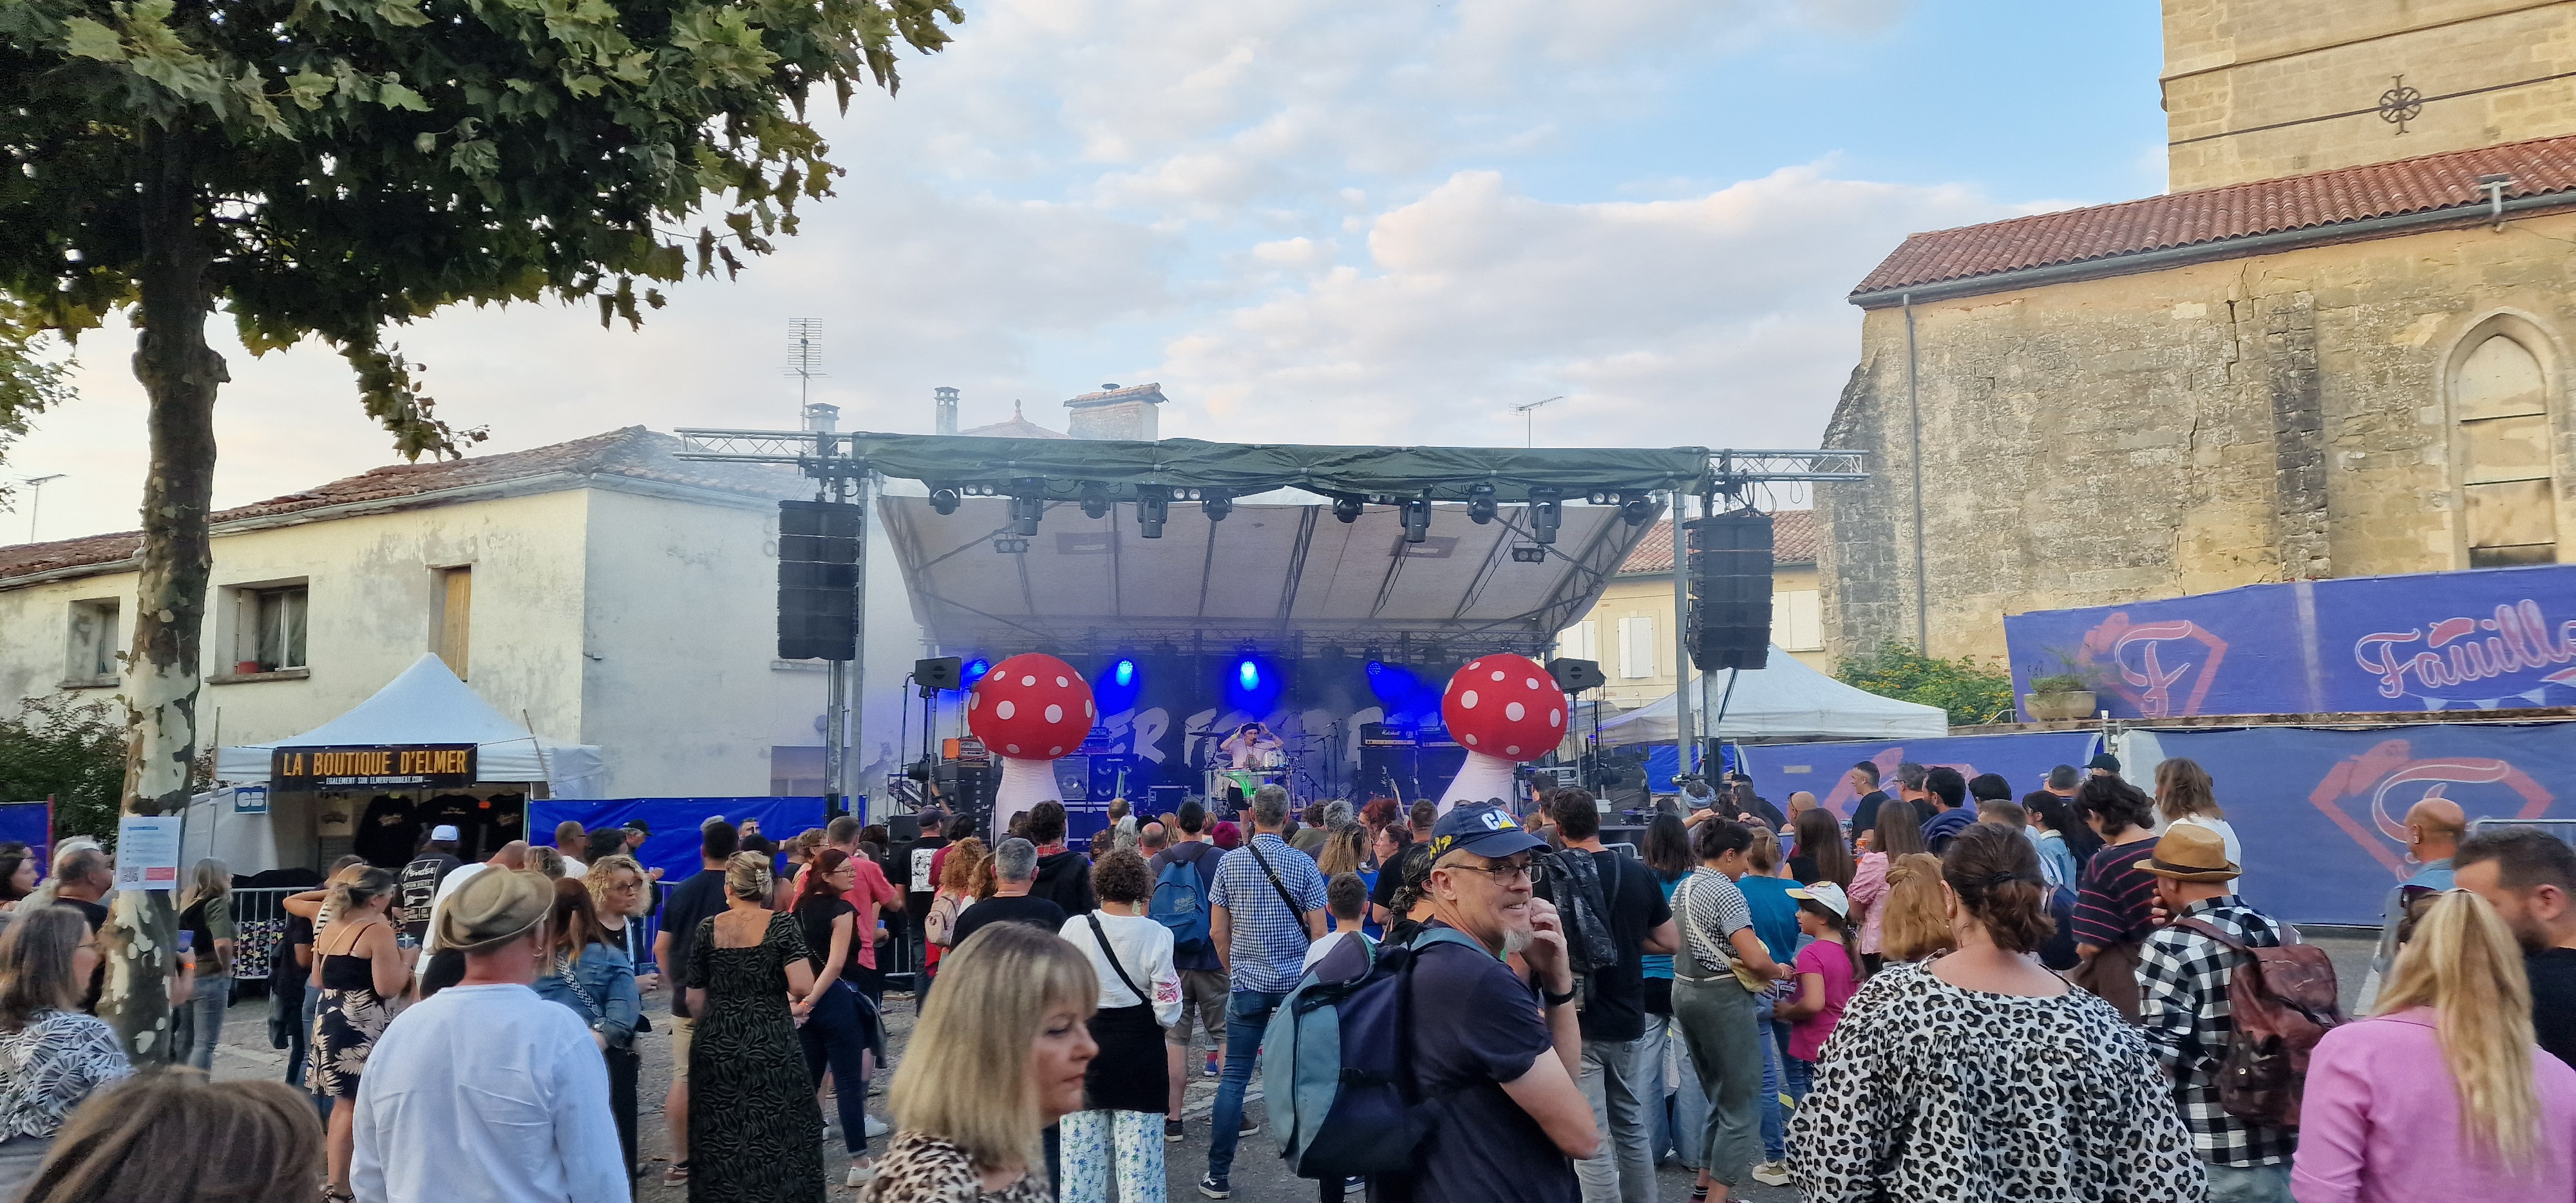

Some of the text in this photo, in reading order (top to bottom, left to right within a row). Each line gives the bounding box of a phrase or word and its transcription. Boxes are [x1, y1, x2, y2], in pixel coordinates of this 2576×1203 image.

[283, 750, 468, 776] LA BOUTIQUE D'ELMER
[401, 861, 437, 882] Fender
